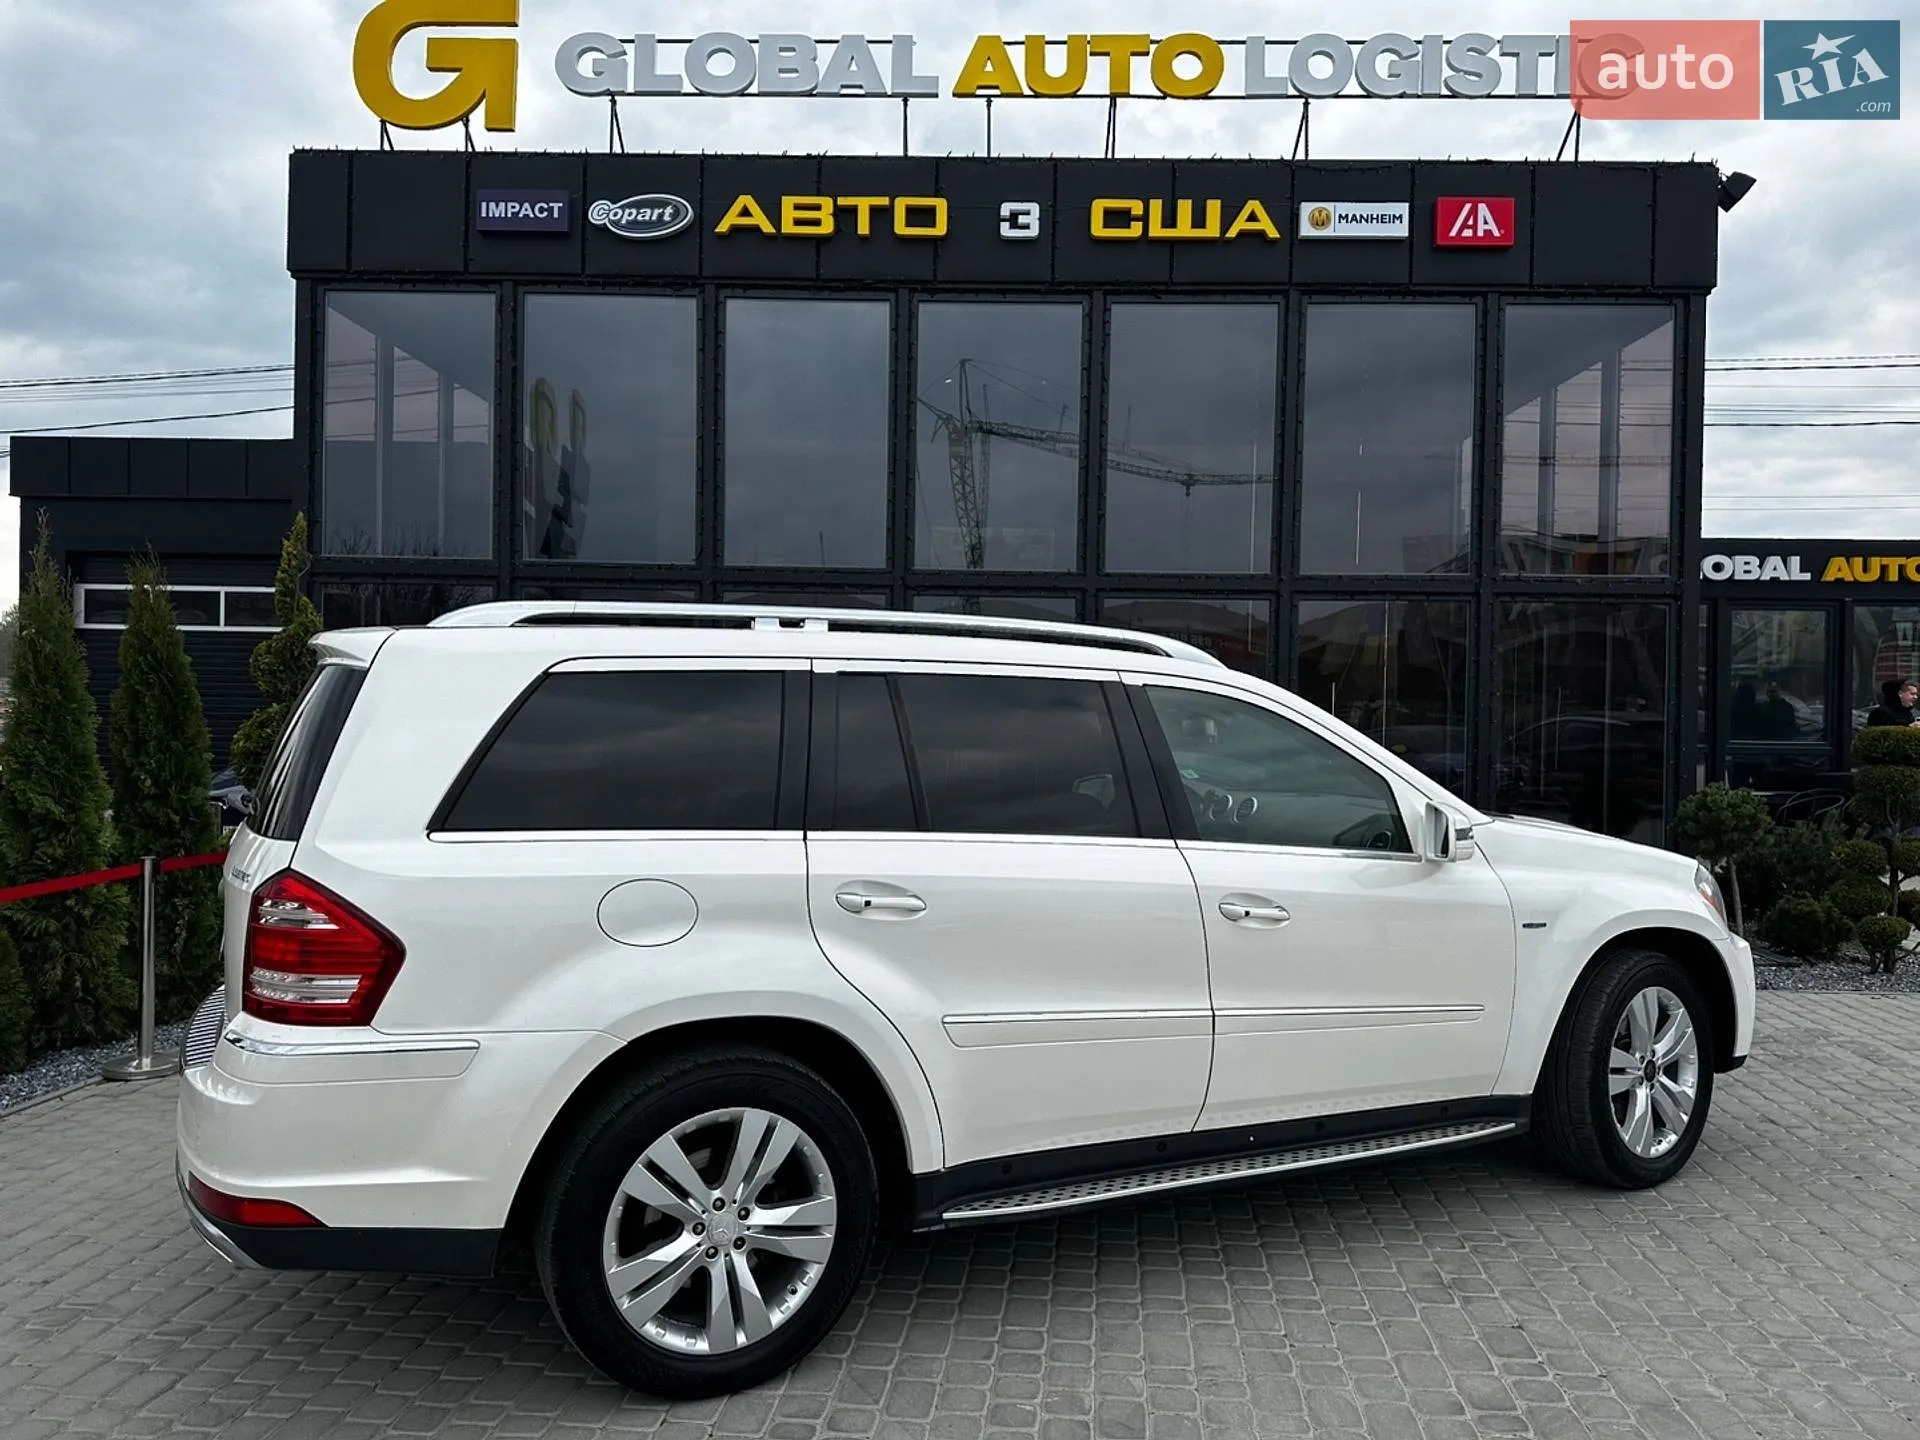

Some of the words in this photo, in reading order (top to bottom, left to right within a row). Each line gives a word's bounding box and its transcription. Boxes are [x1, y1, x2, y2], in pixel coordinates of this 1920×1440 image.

[555, 32, 939, 97] GLOBAL
[952, 33, 1225, 97] AUTO
[481, 201, 563, 219] IMPACT
[591, 202, 674, 224] Copart
[714, 195, 948, 238] АВТО
[1090, 198, 1281, 241] США
[1338, 213, 1403, 224] MANHEIM
[1700, 554, 1811, 581] OBAL
